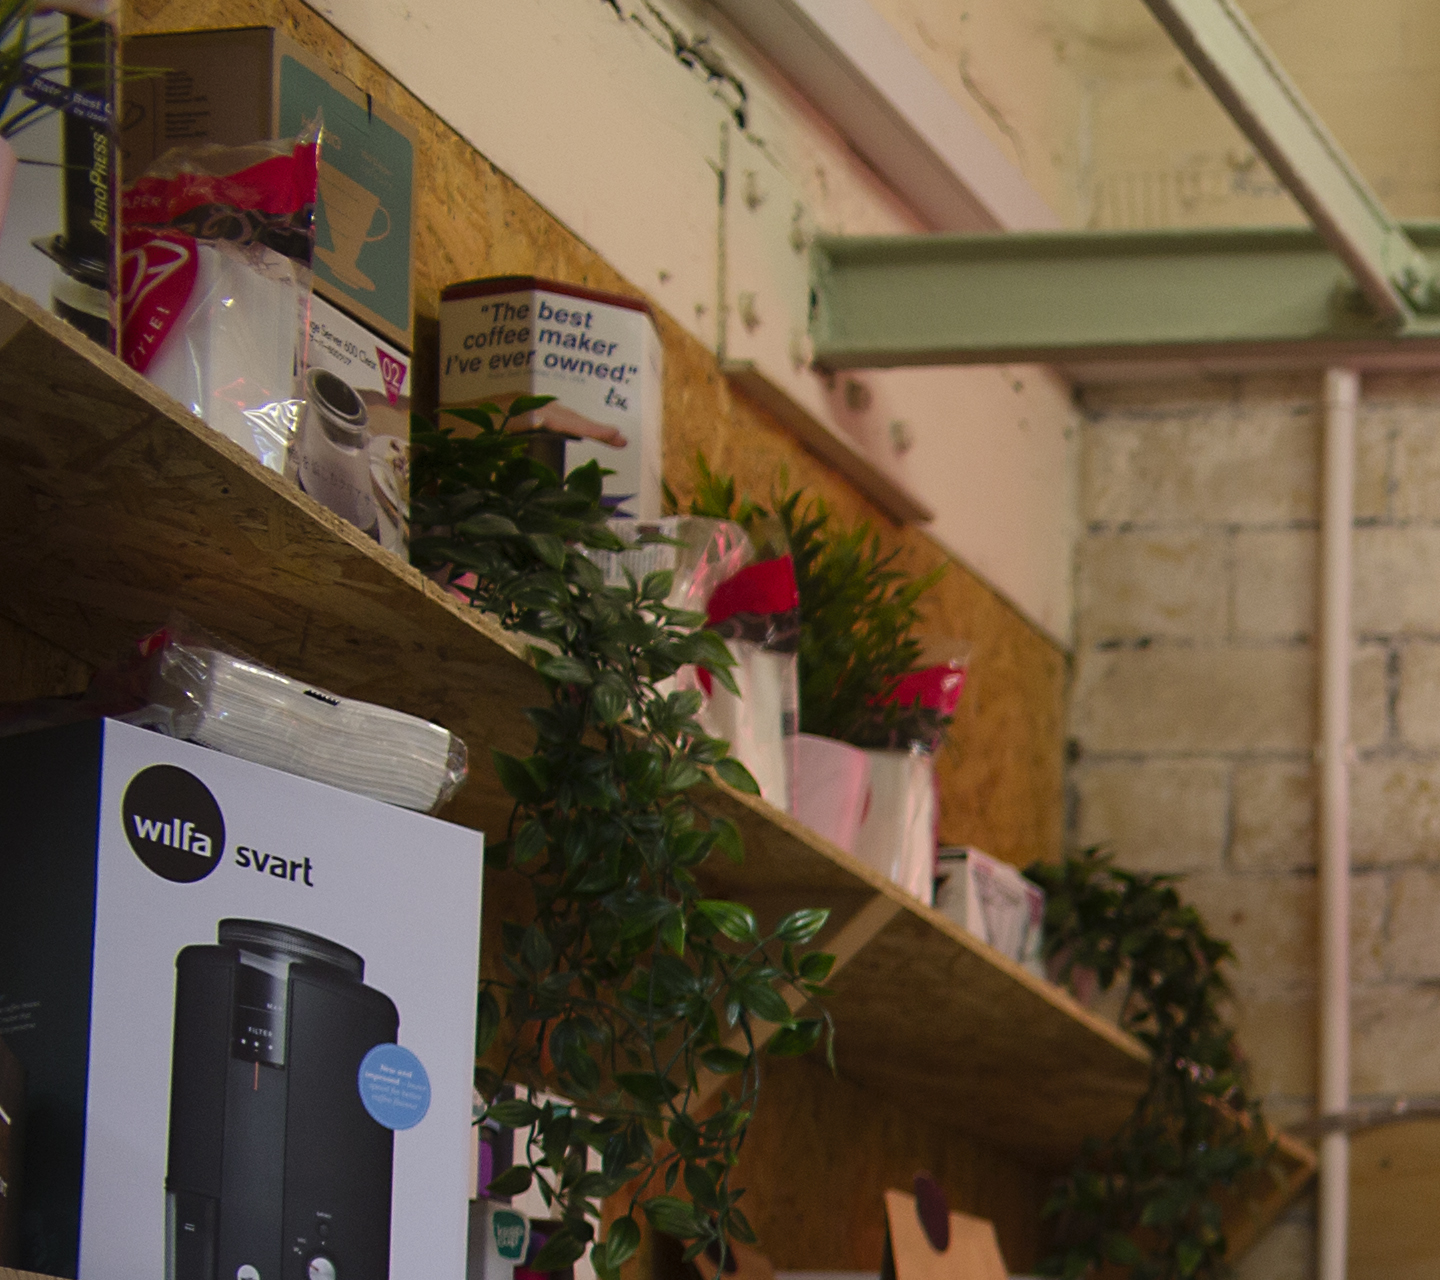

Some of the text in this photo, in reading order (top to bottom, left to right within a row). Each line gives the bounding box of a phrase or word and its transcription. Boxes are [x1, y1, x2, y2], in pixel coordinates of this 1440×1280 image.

[538, 301, 593, 329] best
[463, 326, 618, 357] coffee maker
[382, 357, 400, 384] 02
[445, 356, 480, 375] I've
[488, 350, 535, 368] ever
[133, 814, 314, 887] wilfa svart
